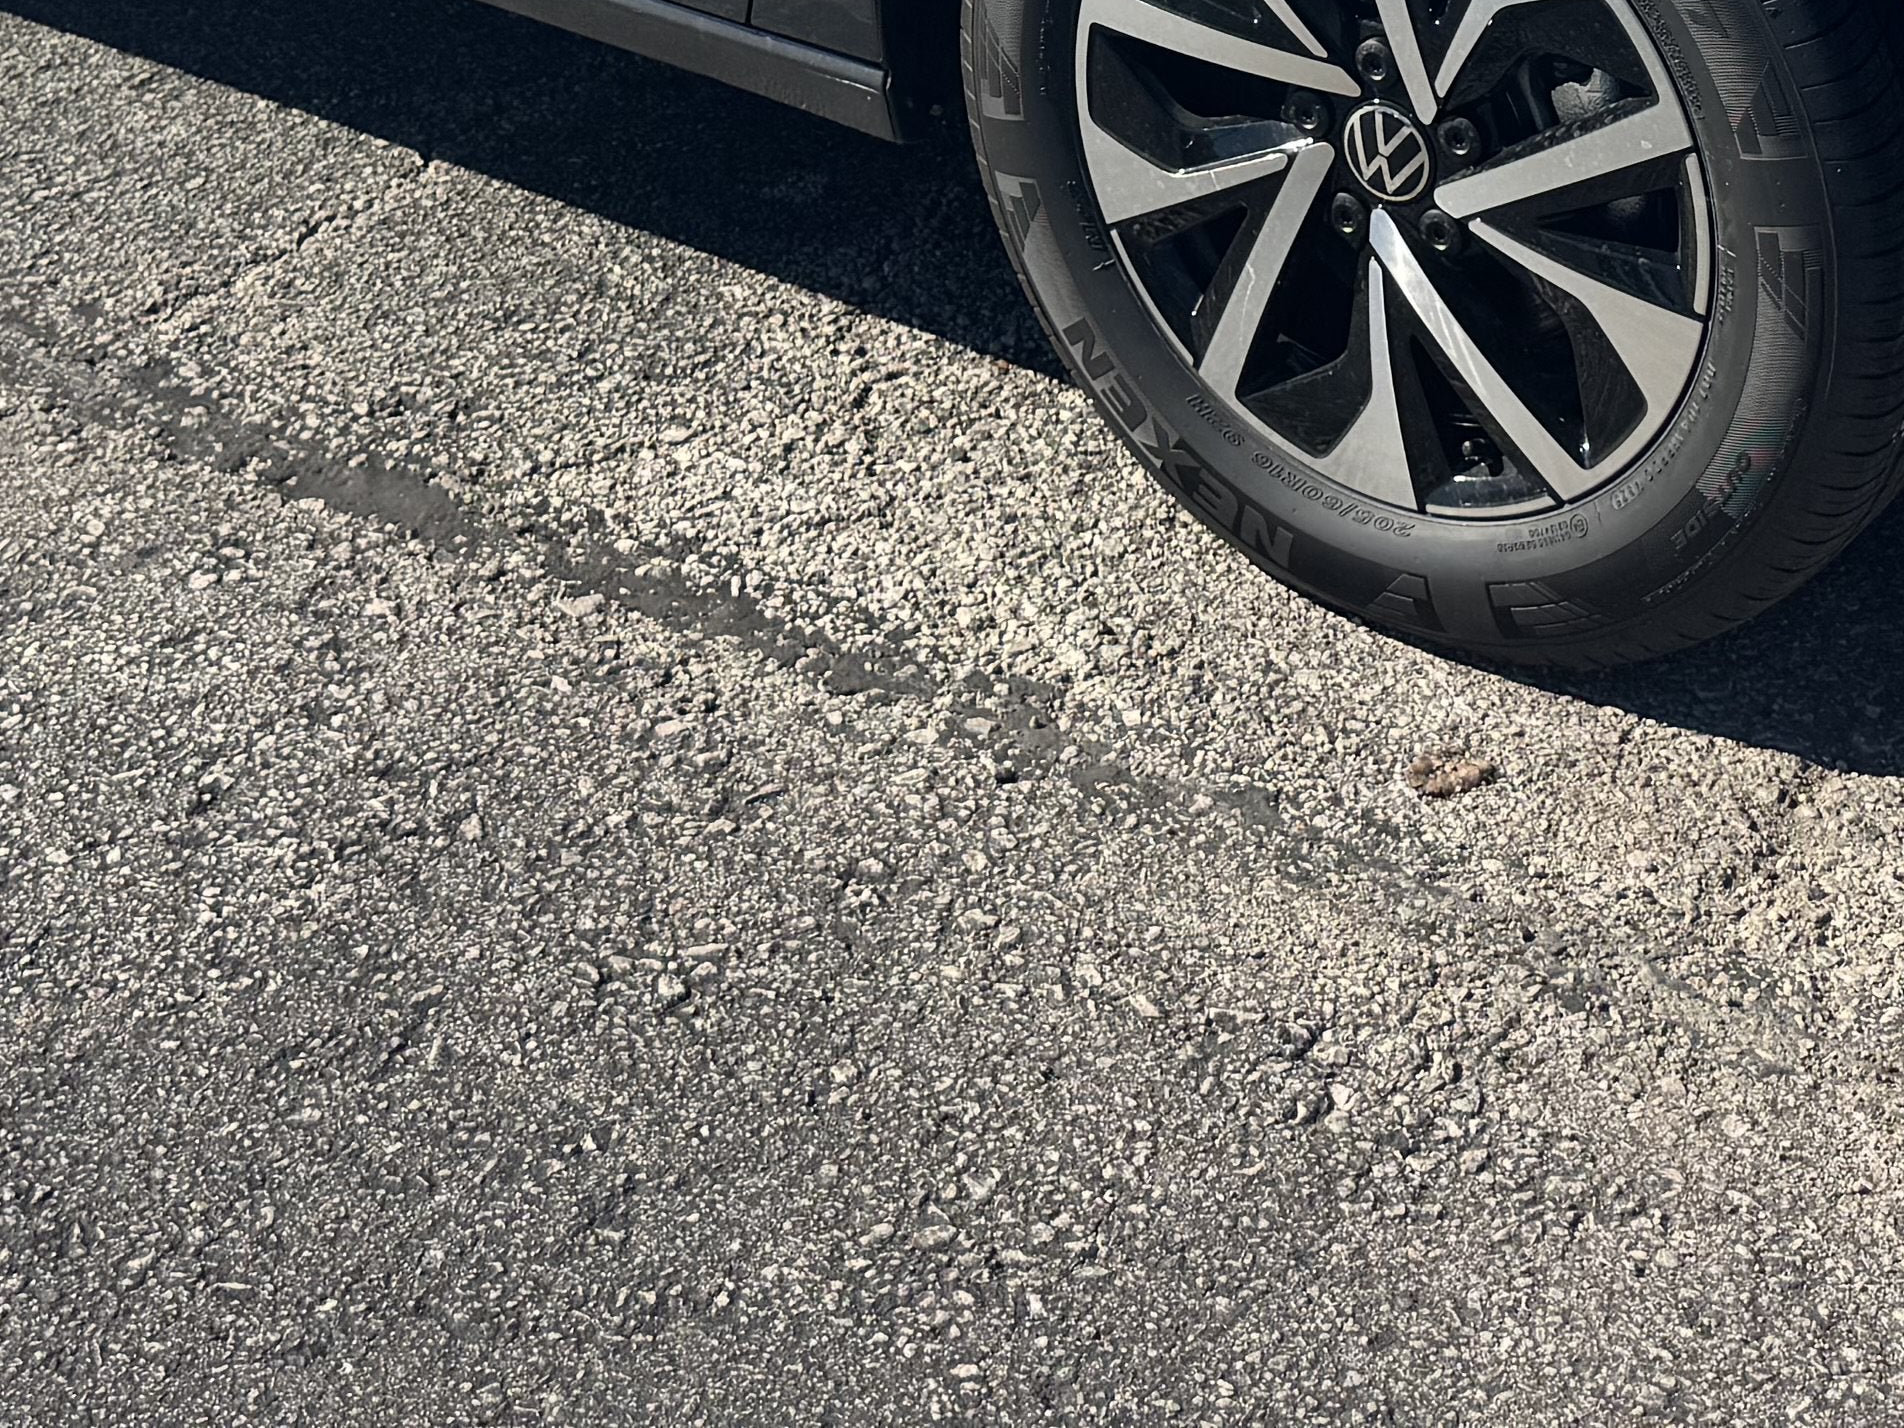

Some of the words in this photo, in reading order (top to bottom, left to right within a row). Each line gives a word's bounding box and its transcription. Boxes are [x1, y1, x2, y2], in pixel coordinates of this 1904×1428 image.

[1345, 105, 1430, 201] VW
[1062, 317, 1294, 568] NEXEN
[1250, 449, 1417, 539] 205/60R16
